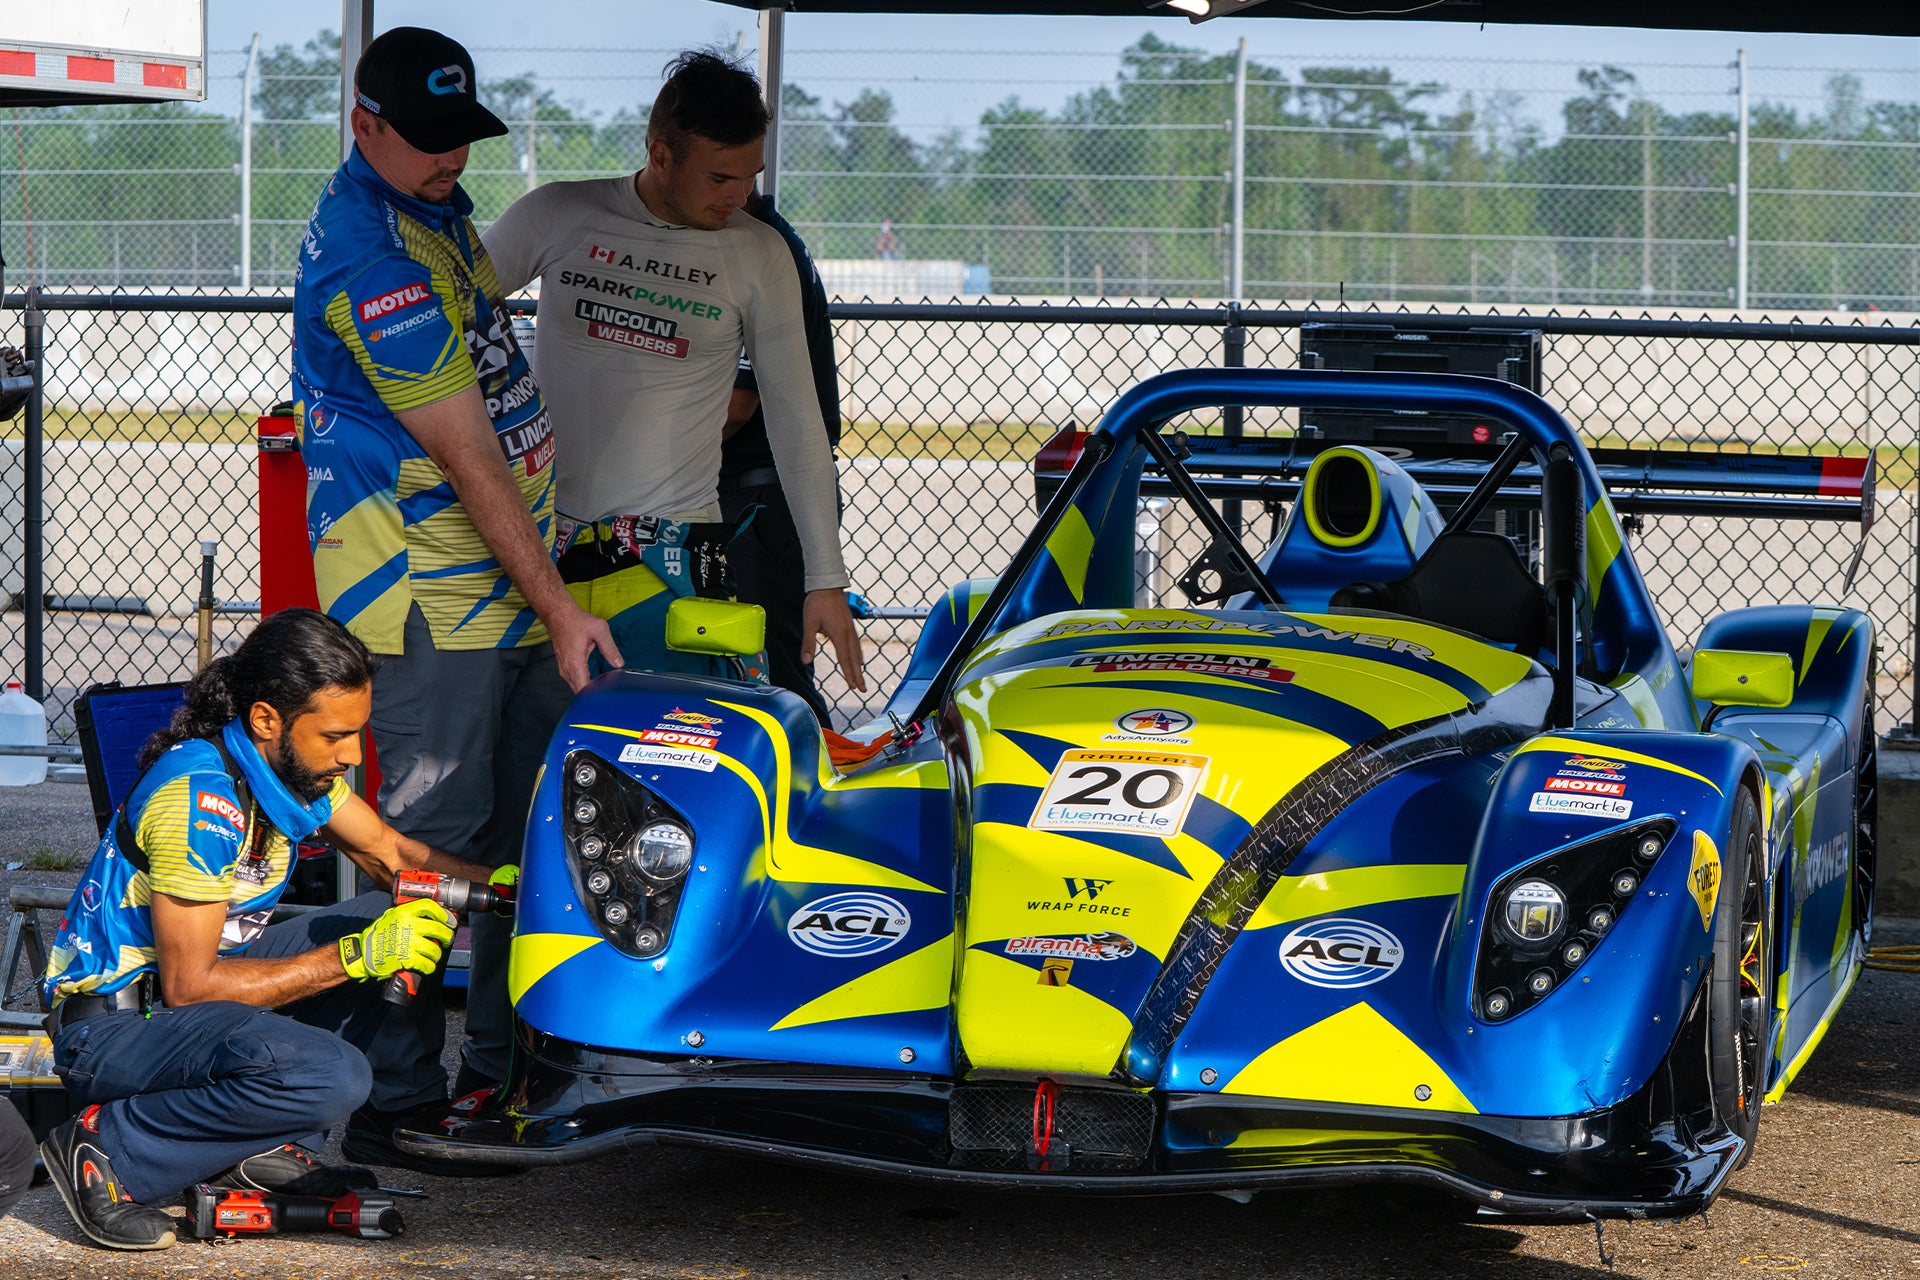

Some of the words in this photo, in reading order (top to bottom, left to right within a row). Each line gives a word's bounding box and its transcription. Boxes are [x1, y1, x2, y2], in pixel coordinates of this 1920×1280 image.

[618, 254, 718, 286] A.RILEY
[363, 285, 430, 320] MOTUL
[559, 270, 723, 321] SPARKPOWER
[579, 301, 673, 338] LINCOLN
[597, 325, 678, 356] WELDERS
[504, 410, 553, 457] LINCO
[533, 436, 556, 470] WELD
[308, 466, 335, 481] GMA
[1081, 653, 1260, 668] LINCOLN
[1115, 661, 1271, 679] WELDERS
[667, 713, 720, 724] SUNOCO
[644, 731, 712, 746] MOTUL
[1103, 734, 1190, 744] AdysArmy.org
[1080, 753, 1189, 765] RADICAL
[1569, 759, 1624, 769] SUNOCO
[1052, 766, 1185, 810] 20
[1549, 779, 1621, 793] MOTUL
[200, 795, 245, 829] MOTUL
[1693, 861, 1719, 893] FOREST
[1027, 901, 1074, 911] WRAP
[1078, 903, 1131, 917] FORCE
[792, 913, 900, 938] ACL
[1007, 936, 1103, 954] piranha
[1012, 948, 1100, 960] PROPELLERS
[1284, 939, 1394, 968] ACL
